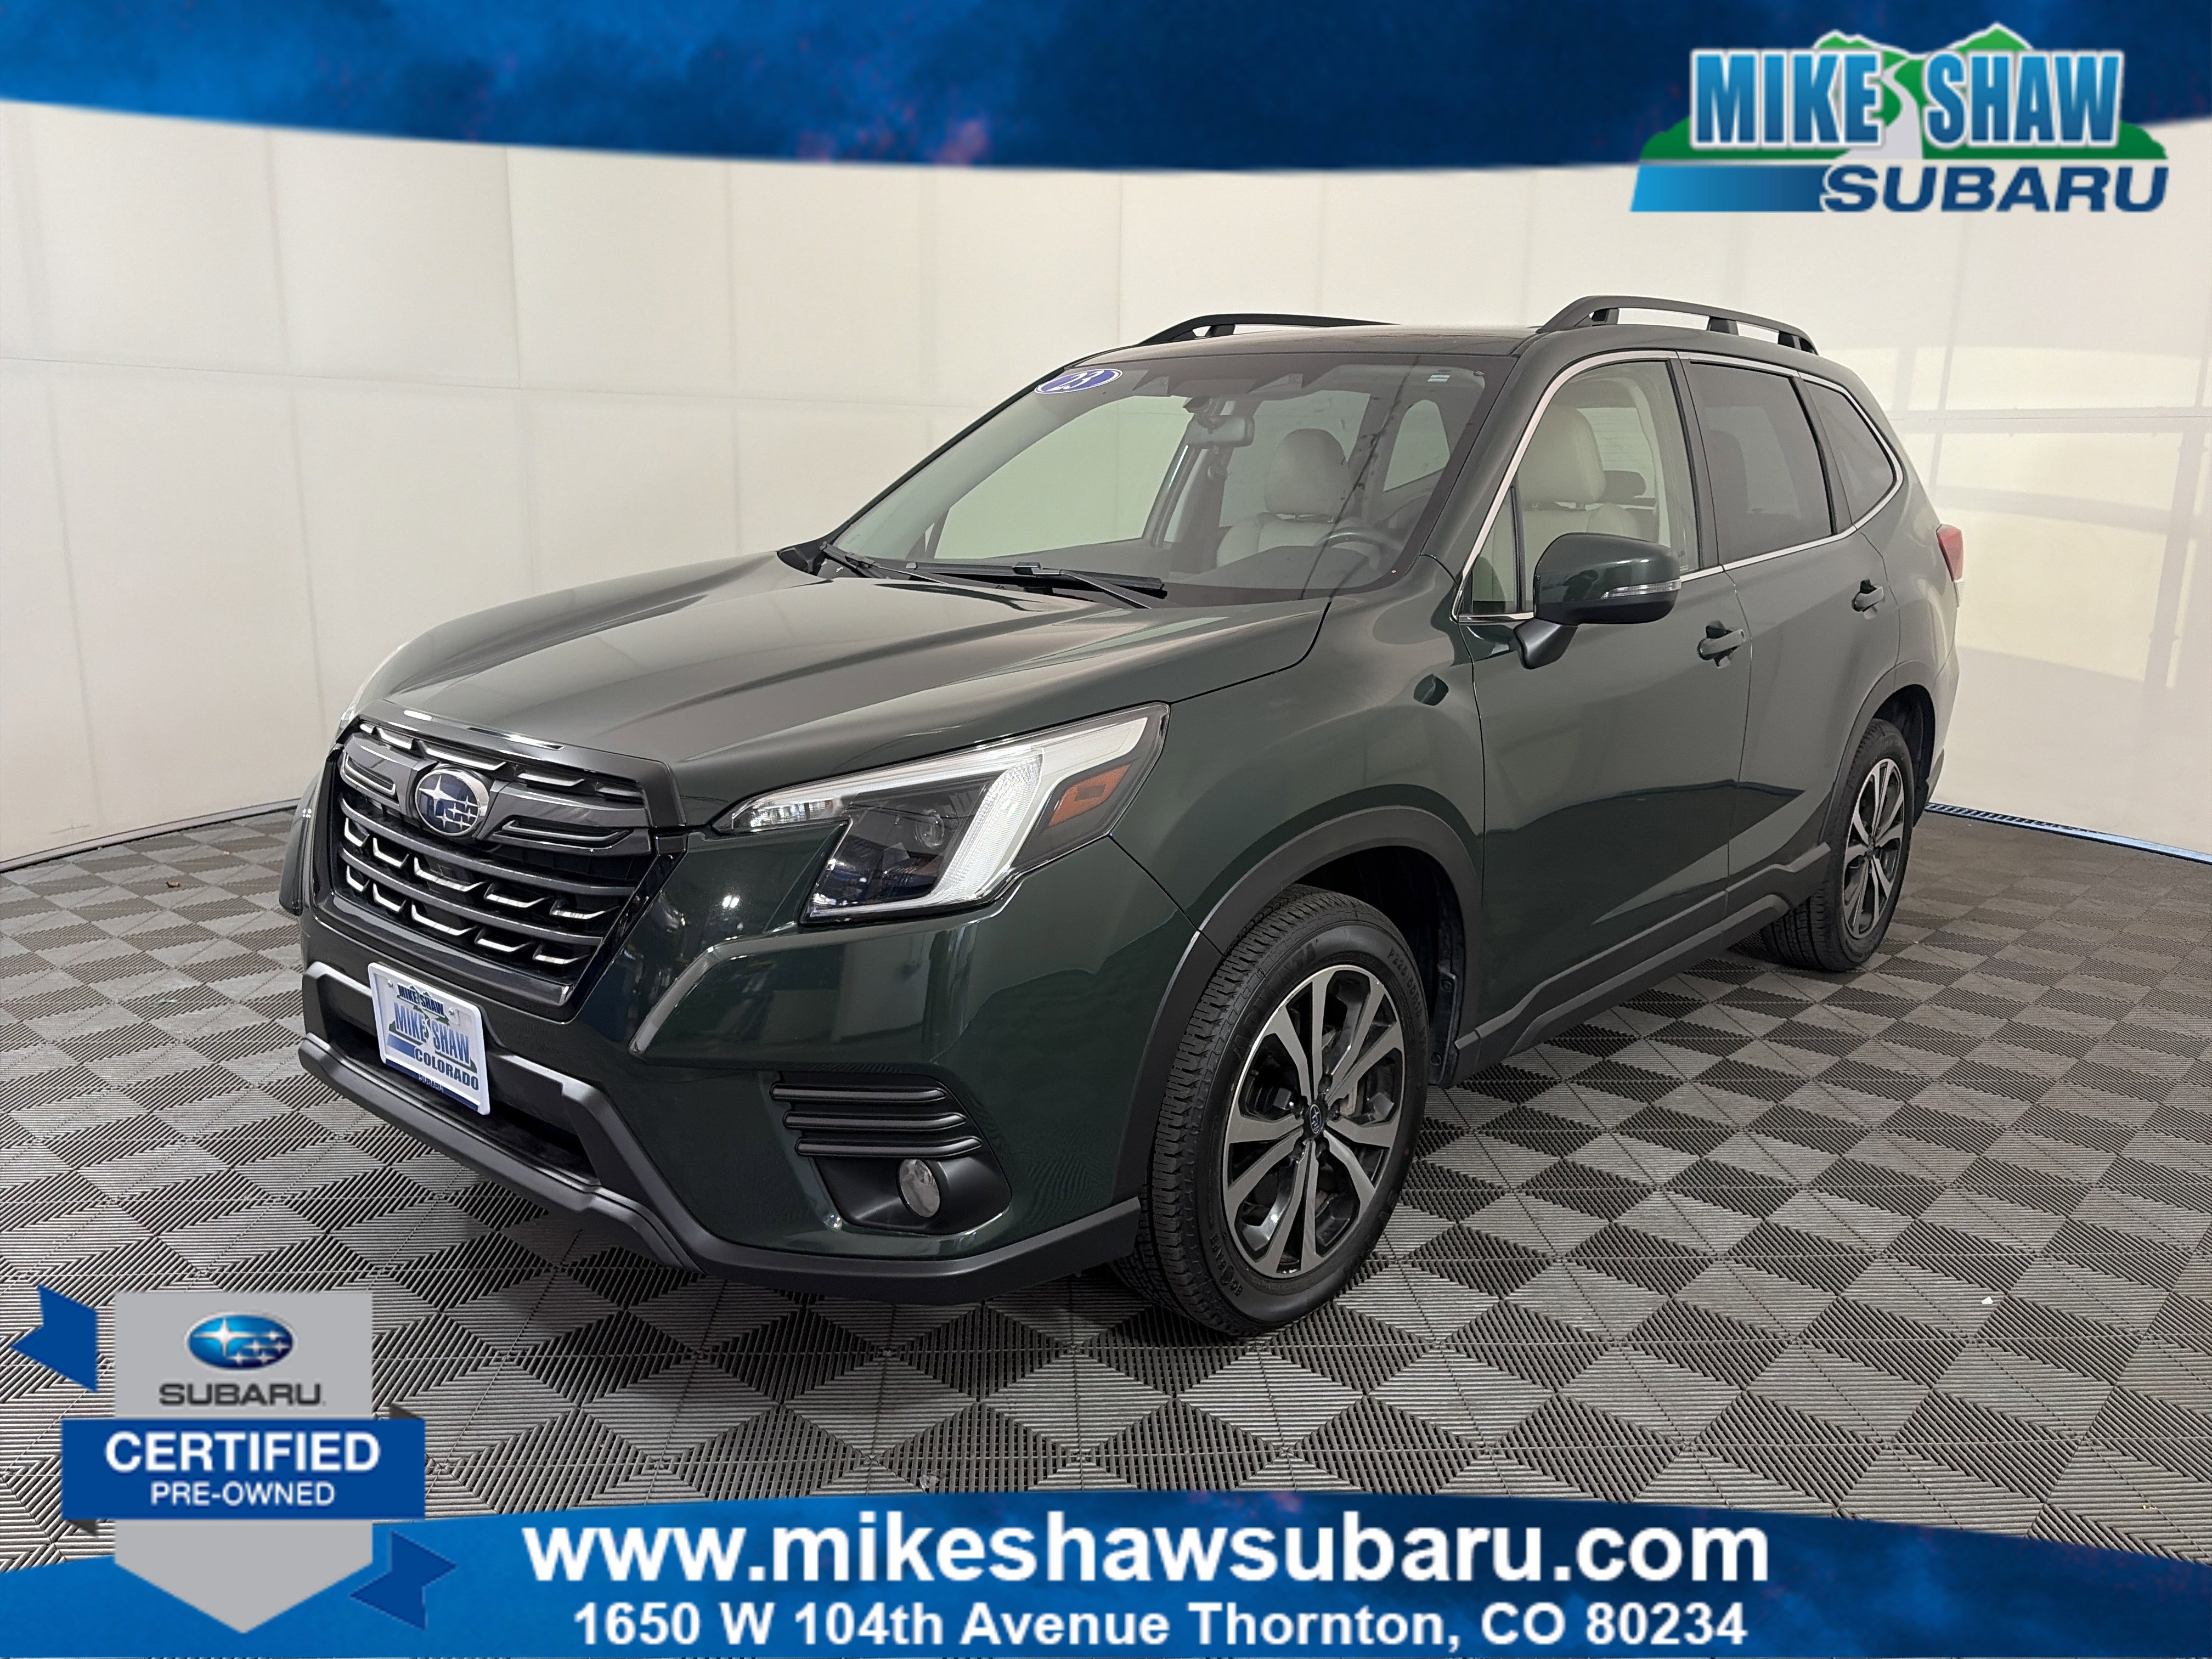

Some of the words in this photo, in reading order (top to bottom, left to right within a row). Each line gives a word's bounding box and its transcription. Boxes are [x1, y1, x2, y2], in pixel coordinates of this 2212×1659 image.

[397, 983, 417, 1005] MIKE
[420, 995, 444, 1015] SHAW
[393, 1001, 428, 1043] MIKE
[429, 1020, 471, 1066] SHAW
[414, 1047, 479, 1091] COLORADO
